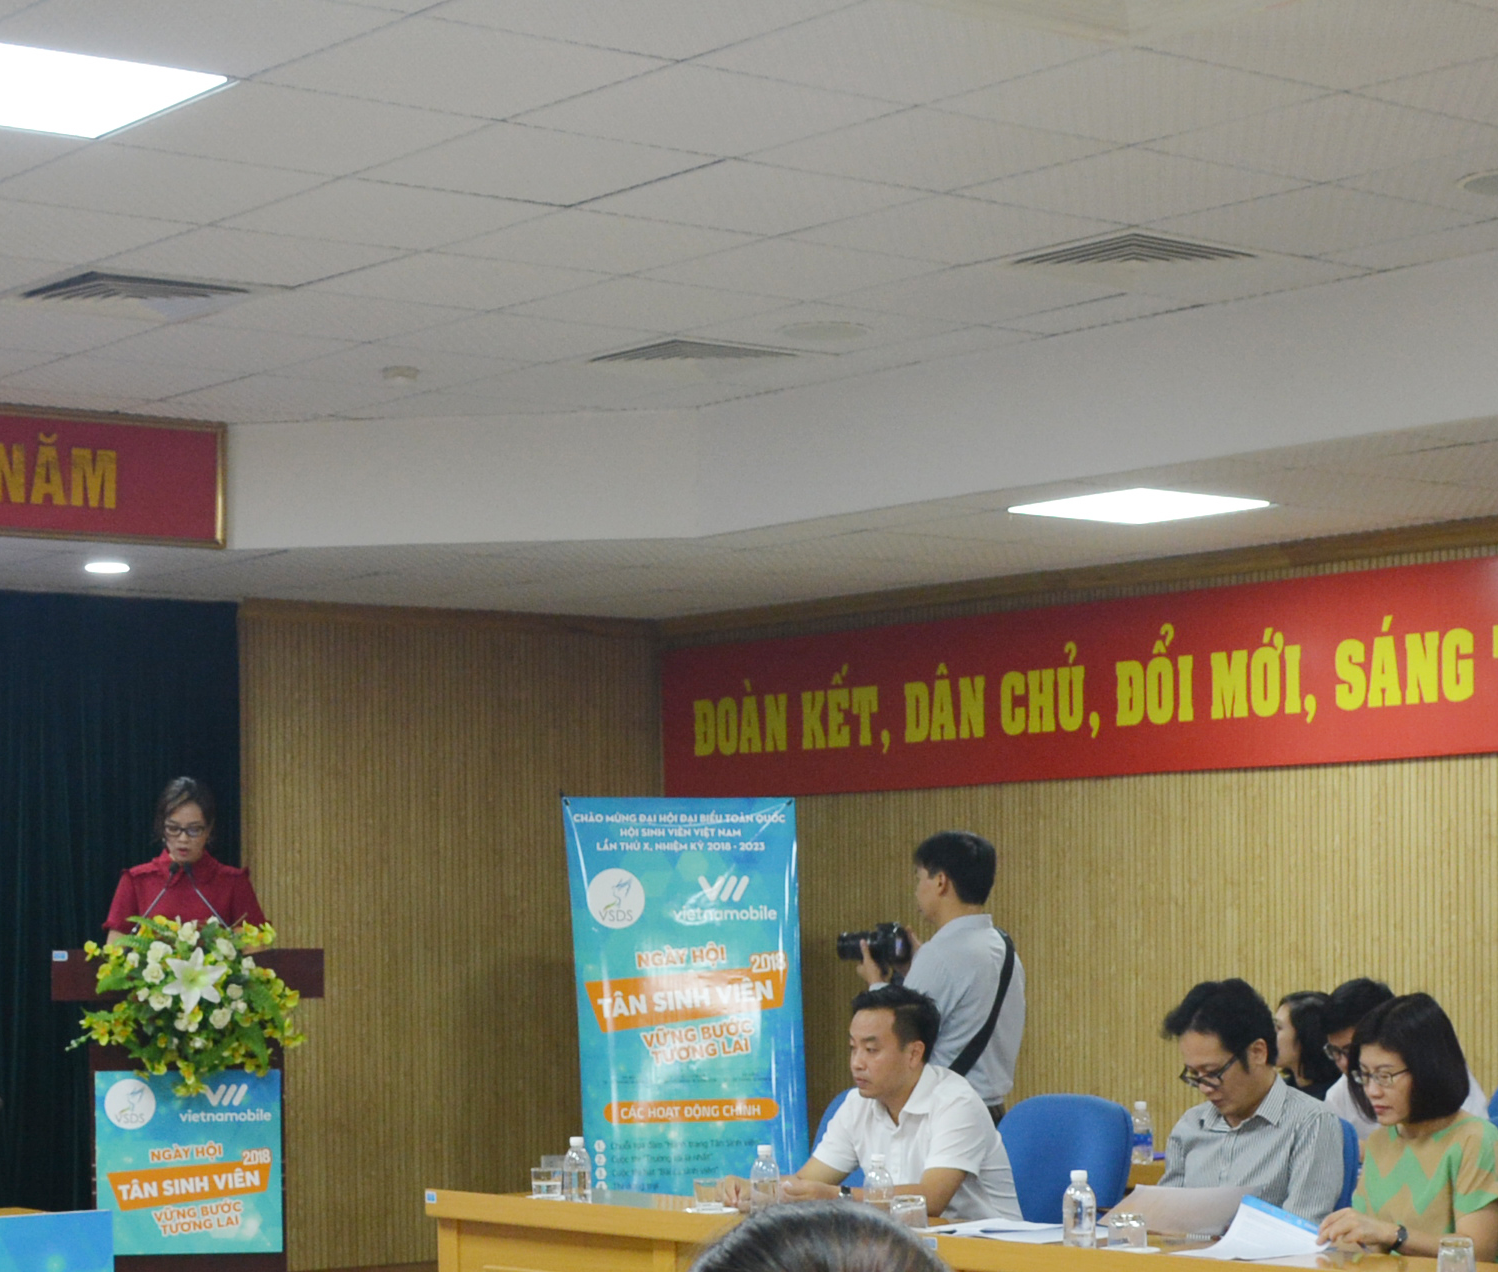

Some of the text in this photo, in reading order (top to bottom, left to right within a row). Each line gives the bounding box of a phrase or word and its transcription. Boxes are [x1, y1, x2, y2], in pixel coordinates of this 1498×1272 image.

[693, 678, 787, 757] ĐOÀN
[800, 662, 892, 754] KẾT,
[904, 662, 985, 745] DÂN
[999, 641, 1101, 738] CHỦ,
[1116, 622, 1193, 729] ĐỔI
[1211, 627, 1317, 722] MỚI,
[1334, 614, 1475, 711] SÁNG
[573, 810, 785, 825] CHÀO MỪNG ĐẠI HỘI ĐẠI BIỂU TOÀN QUỐC
[620, 826, 741, 838] HỘI SINH VIÊN VIỆT NAM
[596, 838, 617, 851] LẦN
[620, 840, 641, 851] THỨ
[655, 840, 687, 852] NHIỆM
[690, 840, 705, 851] KỲ
[707, 842, 731, 851] 2018
[739, 842, 765, 851] 2023
[599, 909, 633, 922] VSDS
[673, 906, 777, 921] vietnamobile
[636, 941, 726, 969] NGÀY HỘI
[751, 953, 787, 973] 2018
[597, 977, 774, 1019] TÂN SINH VIÊN
[642, 1017, 754, 1049] VỮNG BƯỚC
[651, 1038, 750, 1065] TƯƠNG LAI
[115, 1114, 144, 1124] VSDS
[180, 1109, 271, 1122] vietnamobile
[620, 1104, 645, 1119] CÁC
[648, 1106, 681, 1120] HOẠT
[684, 1104, 719, 1119] ĐỘNG
[150, 1141, 223, 1162] NGÀY HỘI
[242, 1149, 271, 1164] 2018
[118, 1168, 260, 1200] TÂN SINH VIÊN
[154, 1198, 242, 1222] VỮNG BƯỚC
[162, 1216, 240, 1235] TƯƠNG LAI
